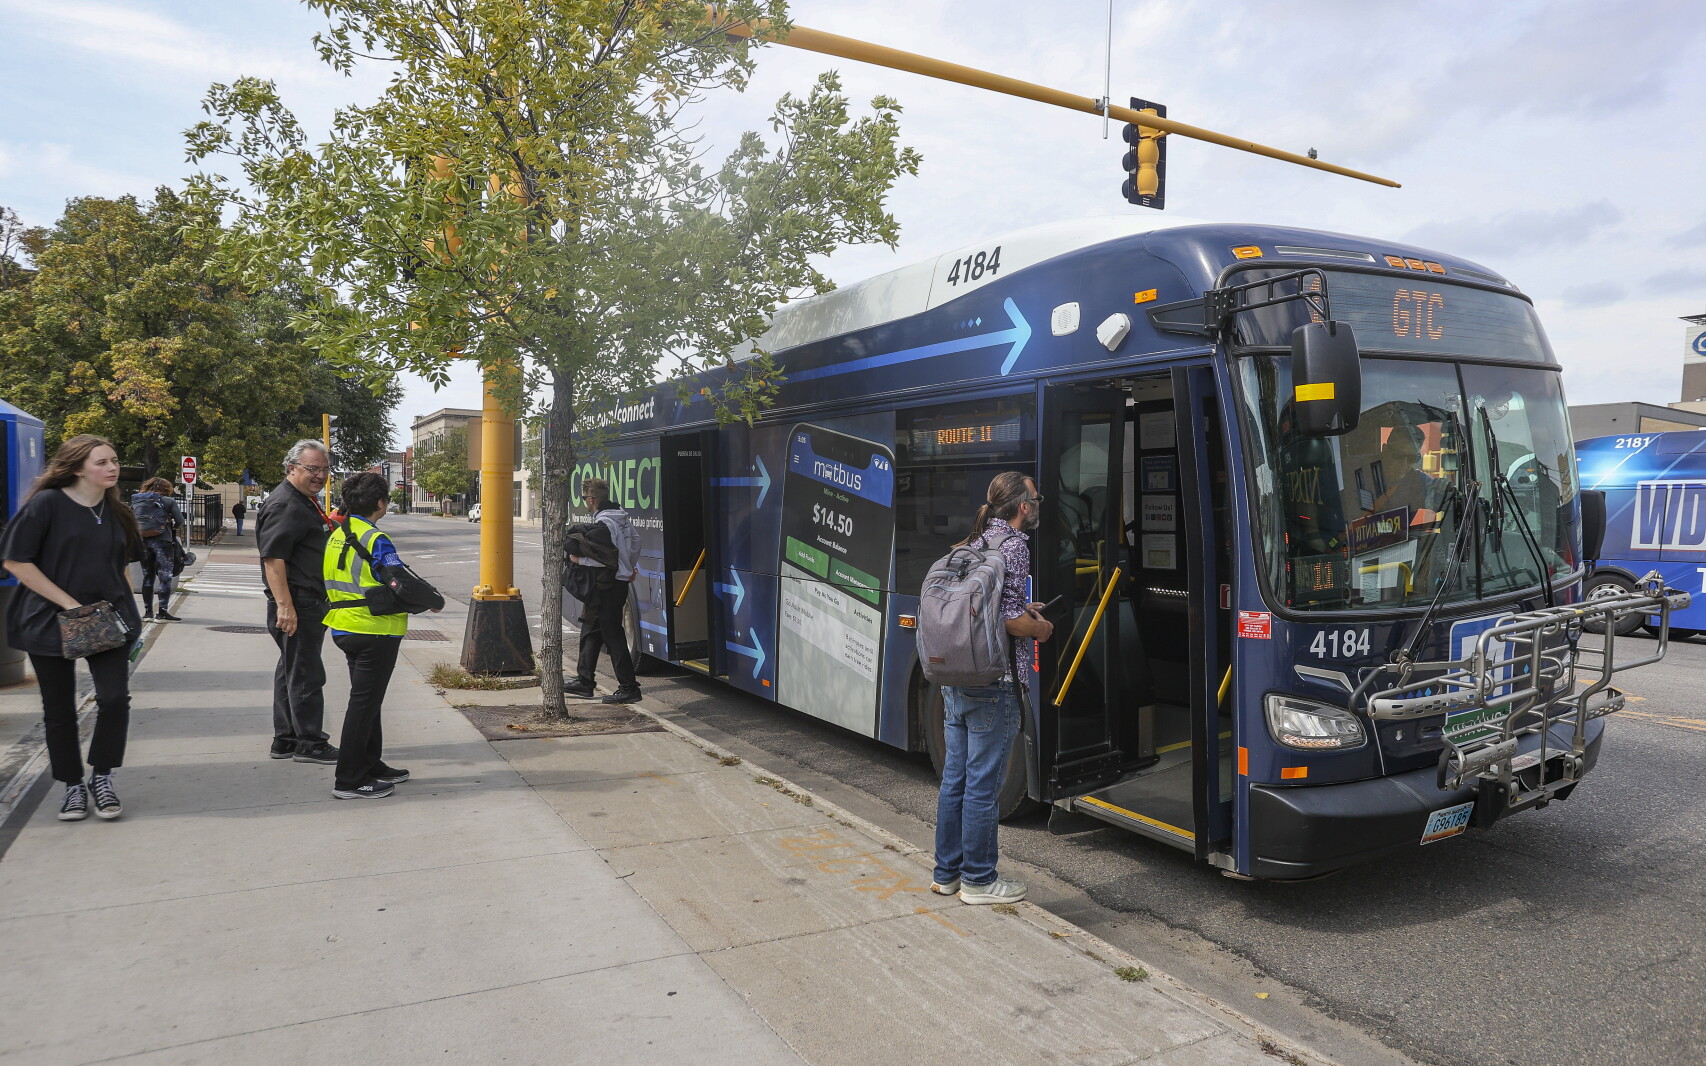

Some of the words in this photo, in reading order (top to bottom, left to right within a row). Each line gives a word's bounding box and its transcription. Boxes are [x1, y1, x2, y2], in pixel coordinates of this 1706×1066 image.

[946, 245, 1002, 287] 4184
[1393, 288, 1445, 340] GTC
[937, 426, 975, 445] ROUTE
[979, 425, 992, 442] 11
[1614, 436, 1651, 449] 2181
[570, 456, 662, 510] CONECT
[645, 516, 664, 532] pricing
[812, 502, 853, 537] $14.50
[1313, 561, 1334, 591] 11
[1310, 629, 1371, 659] 4184
